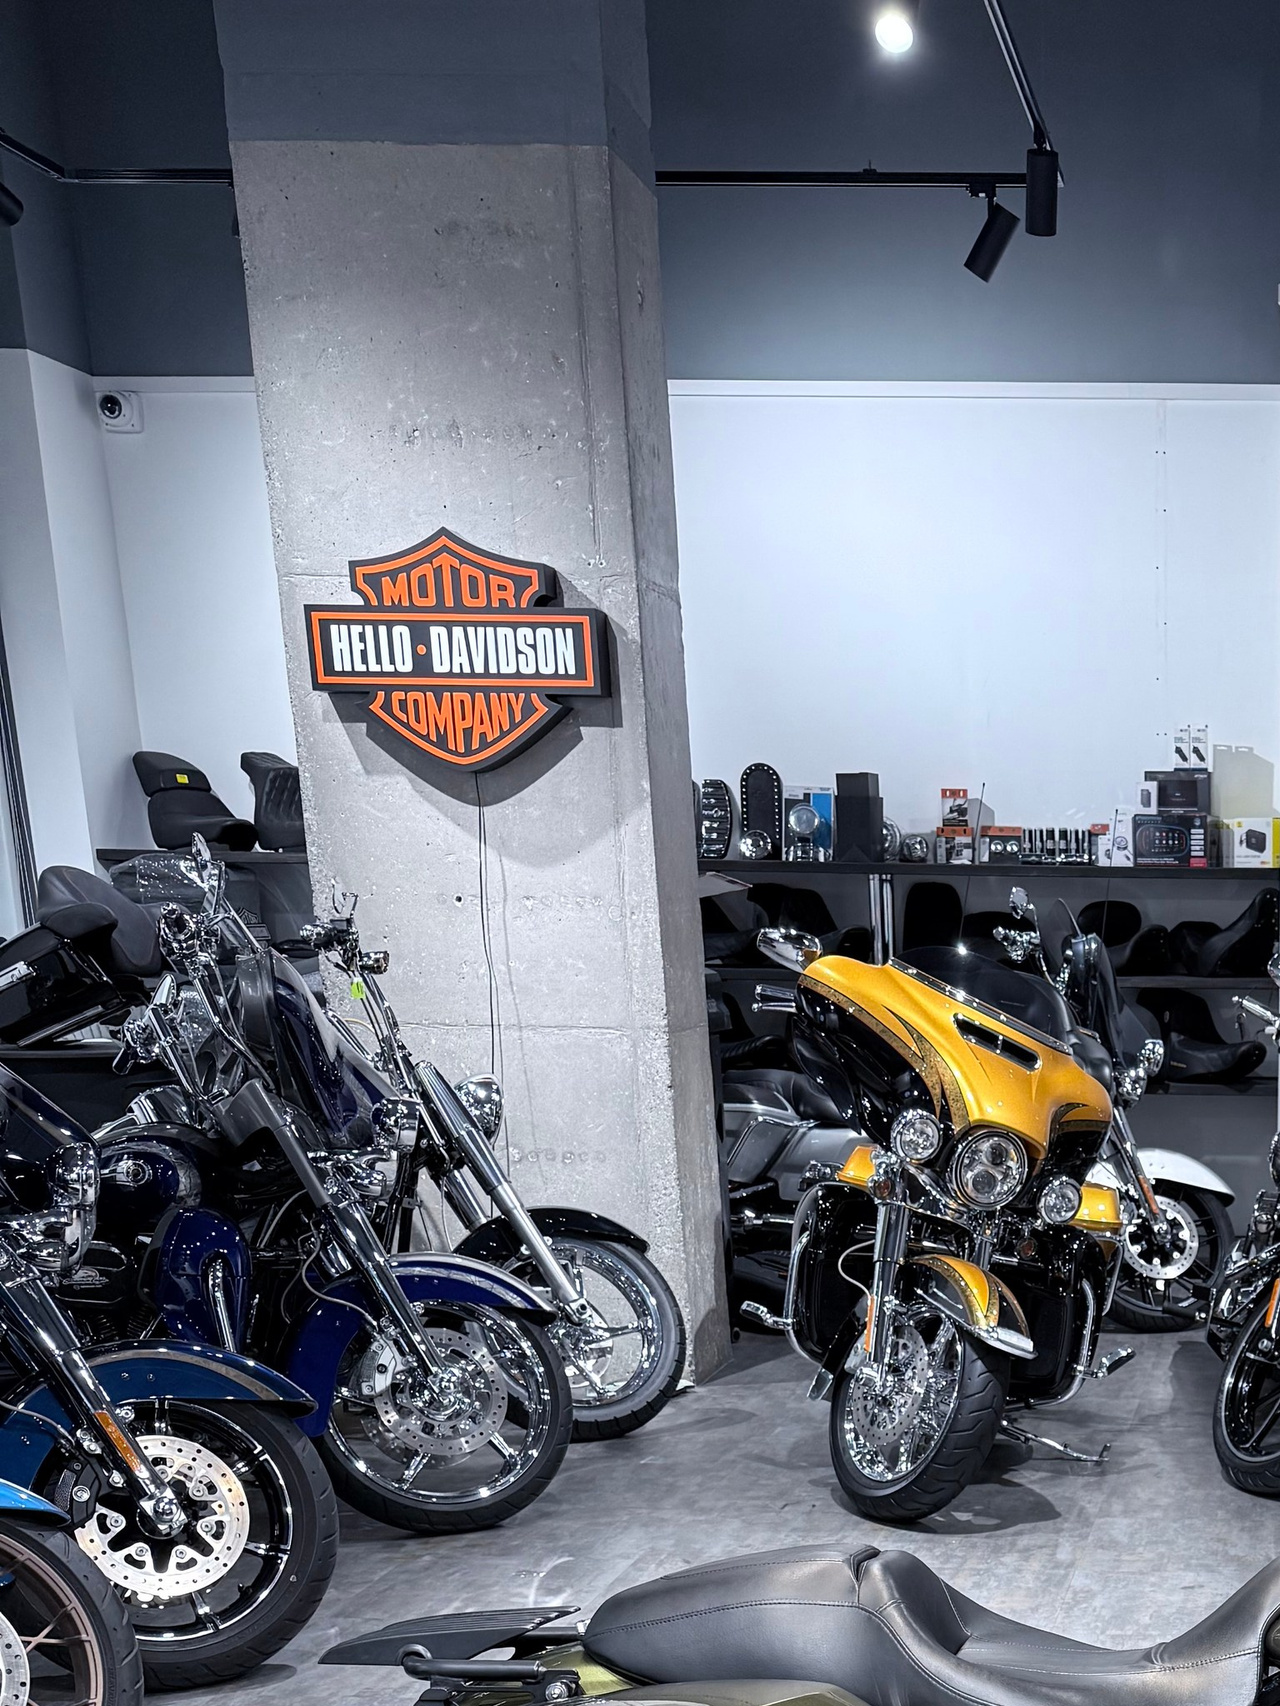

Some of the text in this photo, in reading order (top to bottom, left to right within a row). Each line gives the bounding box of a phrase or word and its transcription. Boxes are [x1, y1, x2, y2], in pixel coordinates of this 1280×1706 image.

[381, 552, 516, 608] MOTOR
[330, 624, 576, 675] HELLO DAVIDSON
[391, 691, 525, 753] COMPANY
